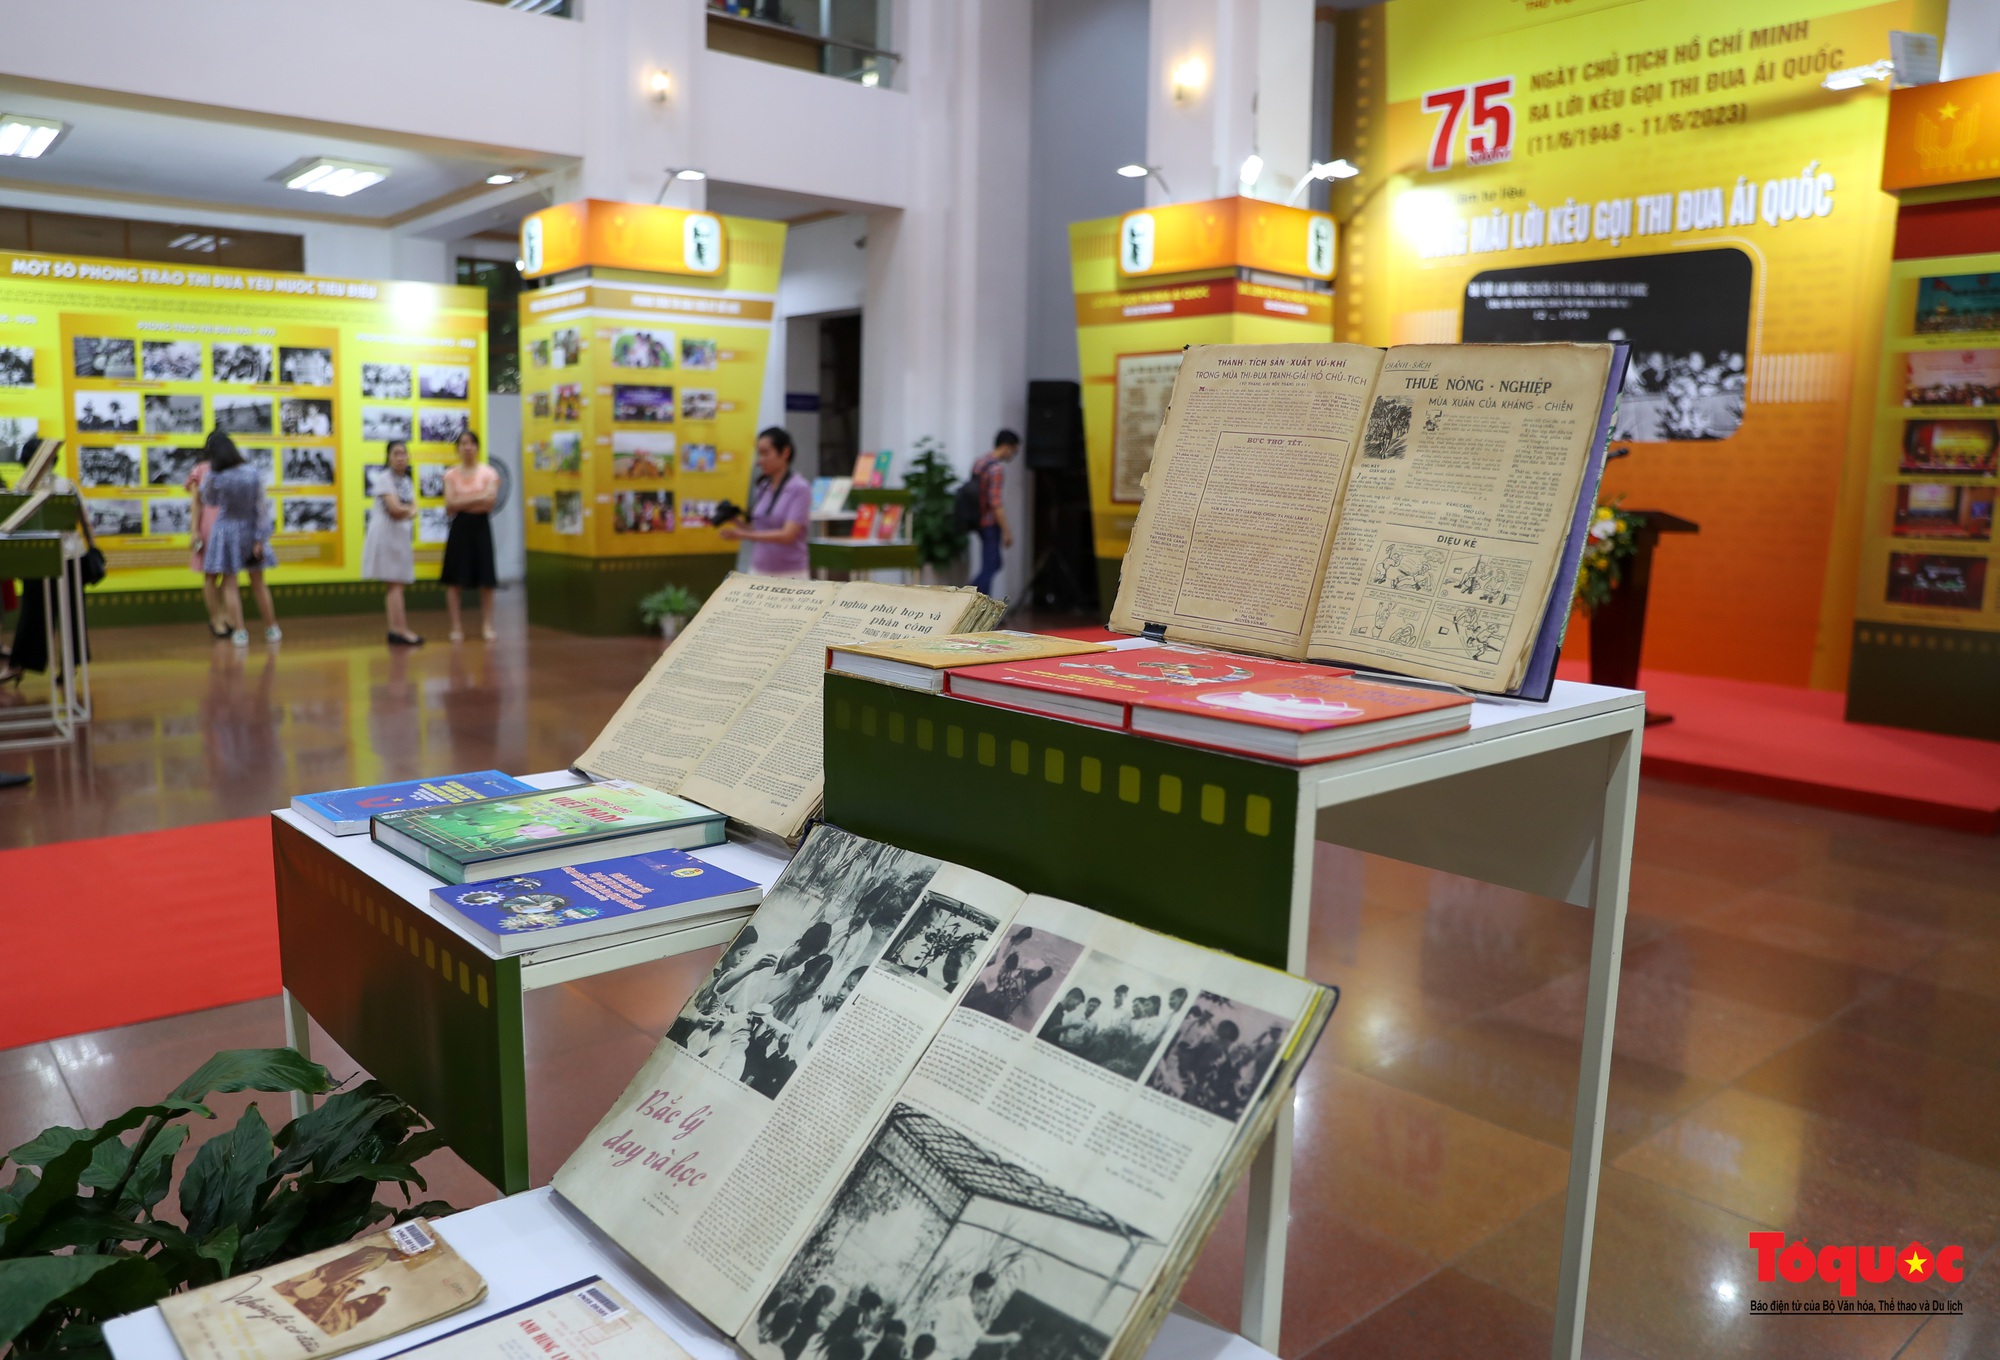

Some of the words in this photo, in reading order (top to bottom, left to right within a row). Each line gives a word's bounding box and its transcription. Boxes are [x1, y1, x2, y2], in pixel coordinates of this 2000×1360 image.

[1530, 66, 1578, 92] NGÀY
[1582, 52, 1621, 81] CHỦ
[1626, 49, 1668, 76] TỊCH
[1674, 35, 1702, 65] HỒ
[1707, 30, 1744, 58] CHÍ
[1750, 20, 1810, 50] MINH
[1528, 104, 1551, 124] RA
[1556, 95, 1584, 120] LỜI
[1588, 87, 1625, 112] KÊU
[1630, 82, 1663, 107] GỌI
[1669, 76, 1700, 99] THI
[1706, 67, 1746, 92] ĐUA
[1754, 57, 1777, 83] ÁI
[1783, 44, 1846, 80] QUỐC
[1423, 76, 1514, 172] 75
[1511, 201, 1546, 249] LỜI
[1548, 197, 1592, 246] KÊU
[1593, 197, 1633, 247] GỌI
[1635, 192, 1675, 237] THI
[1676, 186, 1725, 232] ĐUA
[1728, 175, 1759, 227] ÁI
[1760, 160, 1836, 228] QUỐC
[79, 263, 139, 283] PHONG
[187, 271, 212, 288] THI
[1195, 371, 1220, 380] TRONG
[1405, 373, 1440, 391] THUẾ
[1446, 375, 1484, 392] NÔNG
[1499, 377, 1553, 395] NGHIỆP
[1428, 396, 1448, 407] MÙA
[1451, 397, 1475, 408] XUÂN
[1478, 397, 1497, 409] CỦA
[1501, 398, 1533, 410] KHÁNG
[1544, 400, 1574, 412] CHIẾN
[1437, 534, 1461, 547] DIỆU
[900, 607, 924, 620] hợp
[904, 622, 933, 635] công
[578, 807, 625, 824] NAM
[635, 1089, 684, 1124] Bắc
[602, 1128, 647, 1168] dạy
[642, 1148, 676, 1172] và
[664, 1151, 708, 1188] học
[518, 1319, 542, 1335] ANH
